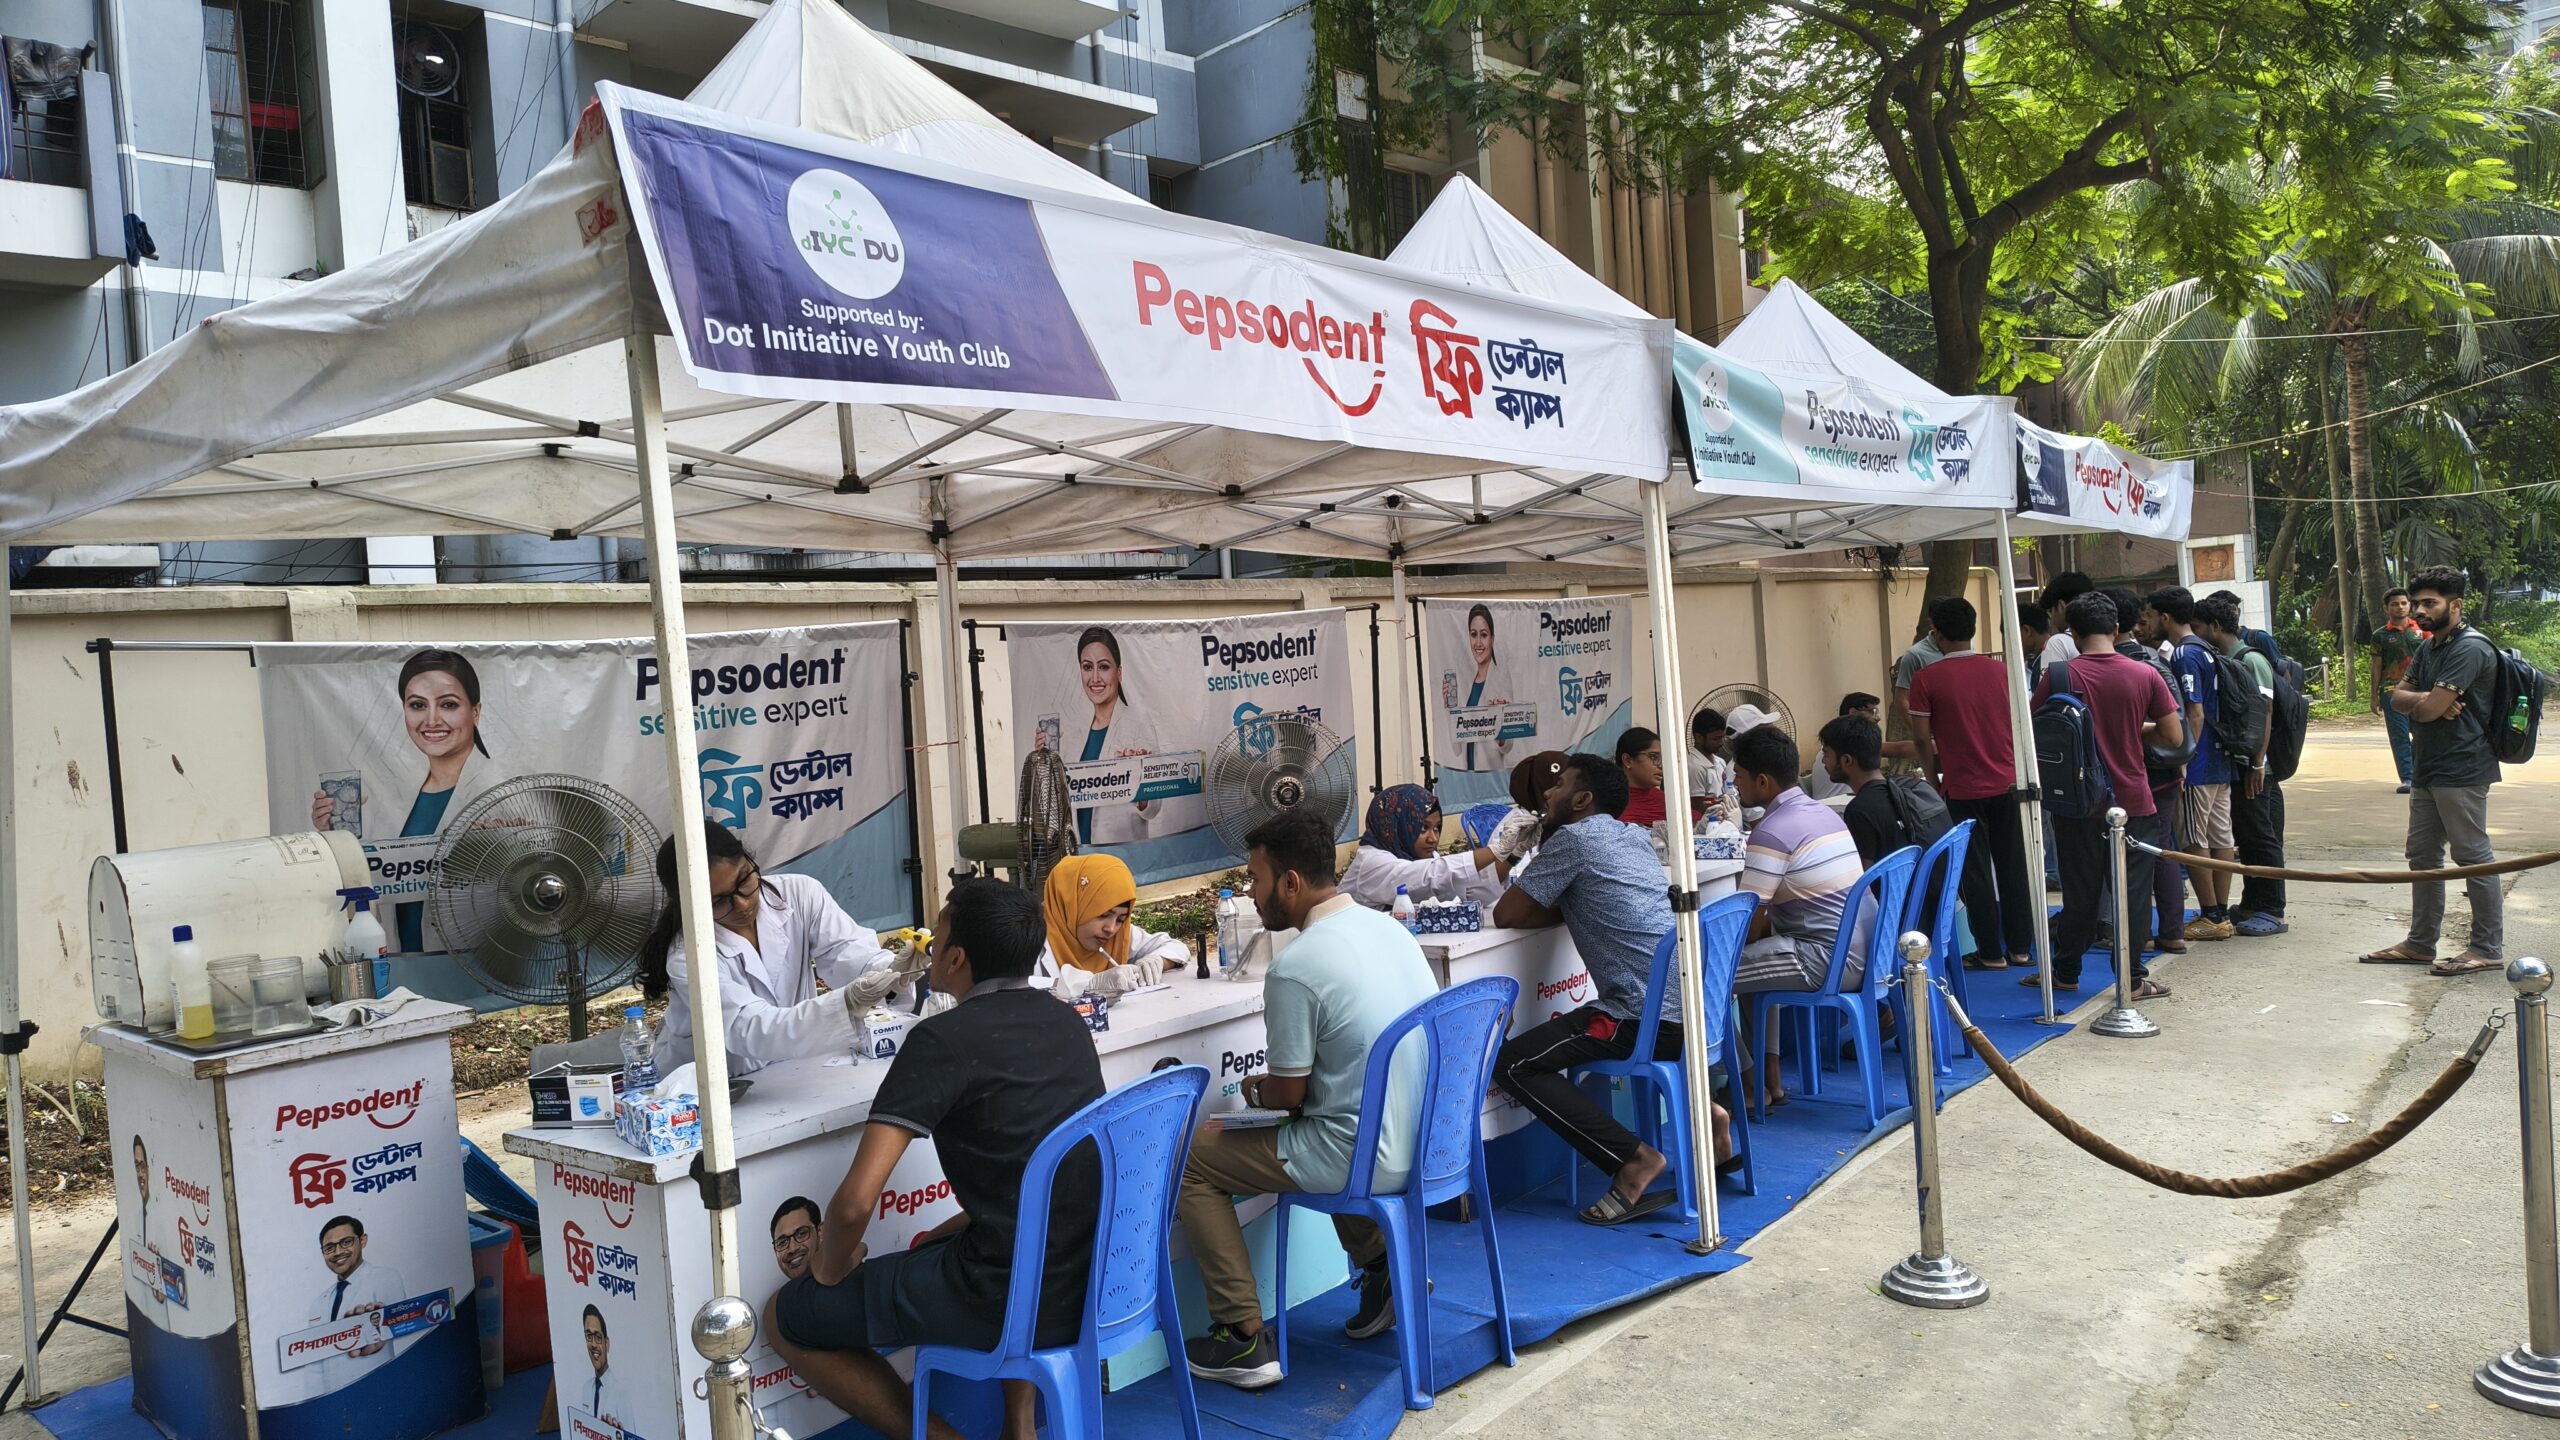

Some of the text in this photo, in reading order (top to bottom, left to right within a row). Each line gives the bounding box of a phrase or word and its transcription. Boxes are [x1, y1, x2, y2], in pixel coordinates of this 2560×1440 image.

[801, 229, 899, 264] dIYC DU
[800, 298, 925, 334] Supported by:
[1132, 260, 1386, 365] Pepsodent
[703, 317, 1011, 370] Dot Initiative Youth Club
[1409, 298, 1484, 419] ফ্রি
[1487, 337, 1568, 386] ডেন্টাল
[1492, 384, 1565, 430] ক্যাম্প
[1806, 389, 1900, 443] Pepsodent
[1704, 432, 1728, 446] Supported
[1903, 405, 1938, 482] ফ্রি
[1936, 421, 1973, 455] ডেন্টাল
[1723, 450, 1741, 464] Youth
[1741, 451, 1756, 466] Club
[1804, 442, 1900, 479] sensitive expert
[1937, 458, 1971, 486] ক্যাম্প
[1540, 610, 1611, 642] Pepsodent
[1200, 628, 1317, 671] Pepsodent
[1538, 638, 1612, 657] sensitive expert
[636, 648, 846, 707] Ppsodent
[1272, 664, 1319, 687] expert
[1559, 666, 1583, 716] ফ্রি
[1584, 670, 1612, 694] ডেন্টাল
[764, 693, 849, 727] expert
[1583, 693, 1608, 712] ক্যাম্প
[1456, 715, 1497, 730] Pepsodent
[769, 750, 853, 793] ডেন্টাল
[1143, 762, 1179, 773] SENSITIVITY
[769, 787, 844, 821] ক্যাম্প
[1100, 788, 1132, 802] expert
[1537, 968, 1589, 1000] Pepsodent
[873, 1025, 903, 1035] COMFIT
[879, 1039, 890, 1050] M
[275, 1080, 423, 1132] Pepsodent
[352, 1142, 423, 1176] ডেন্টাল
[165, 1166, 210, 1207] Pepsodent
[289, 1153, 347, 1209] ফ্রি
[351, 1165, 417, 1194] ক্যাম্প
[553, 1162, 635, 1206] Pepsodent
[879, 1179, 951, 1220] Pepso
[178, 1216, 194, 1267] ফ্রি
[563, 1220, 594, 1287] ফ্রি
[596, 1245, 638, 1275] ডেন্টাল
[597, 1270, 636, 1301] ক্যাম্প
